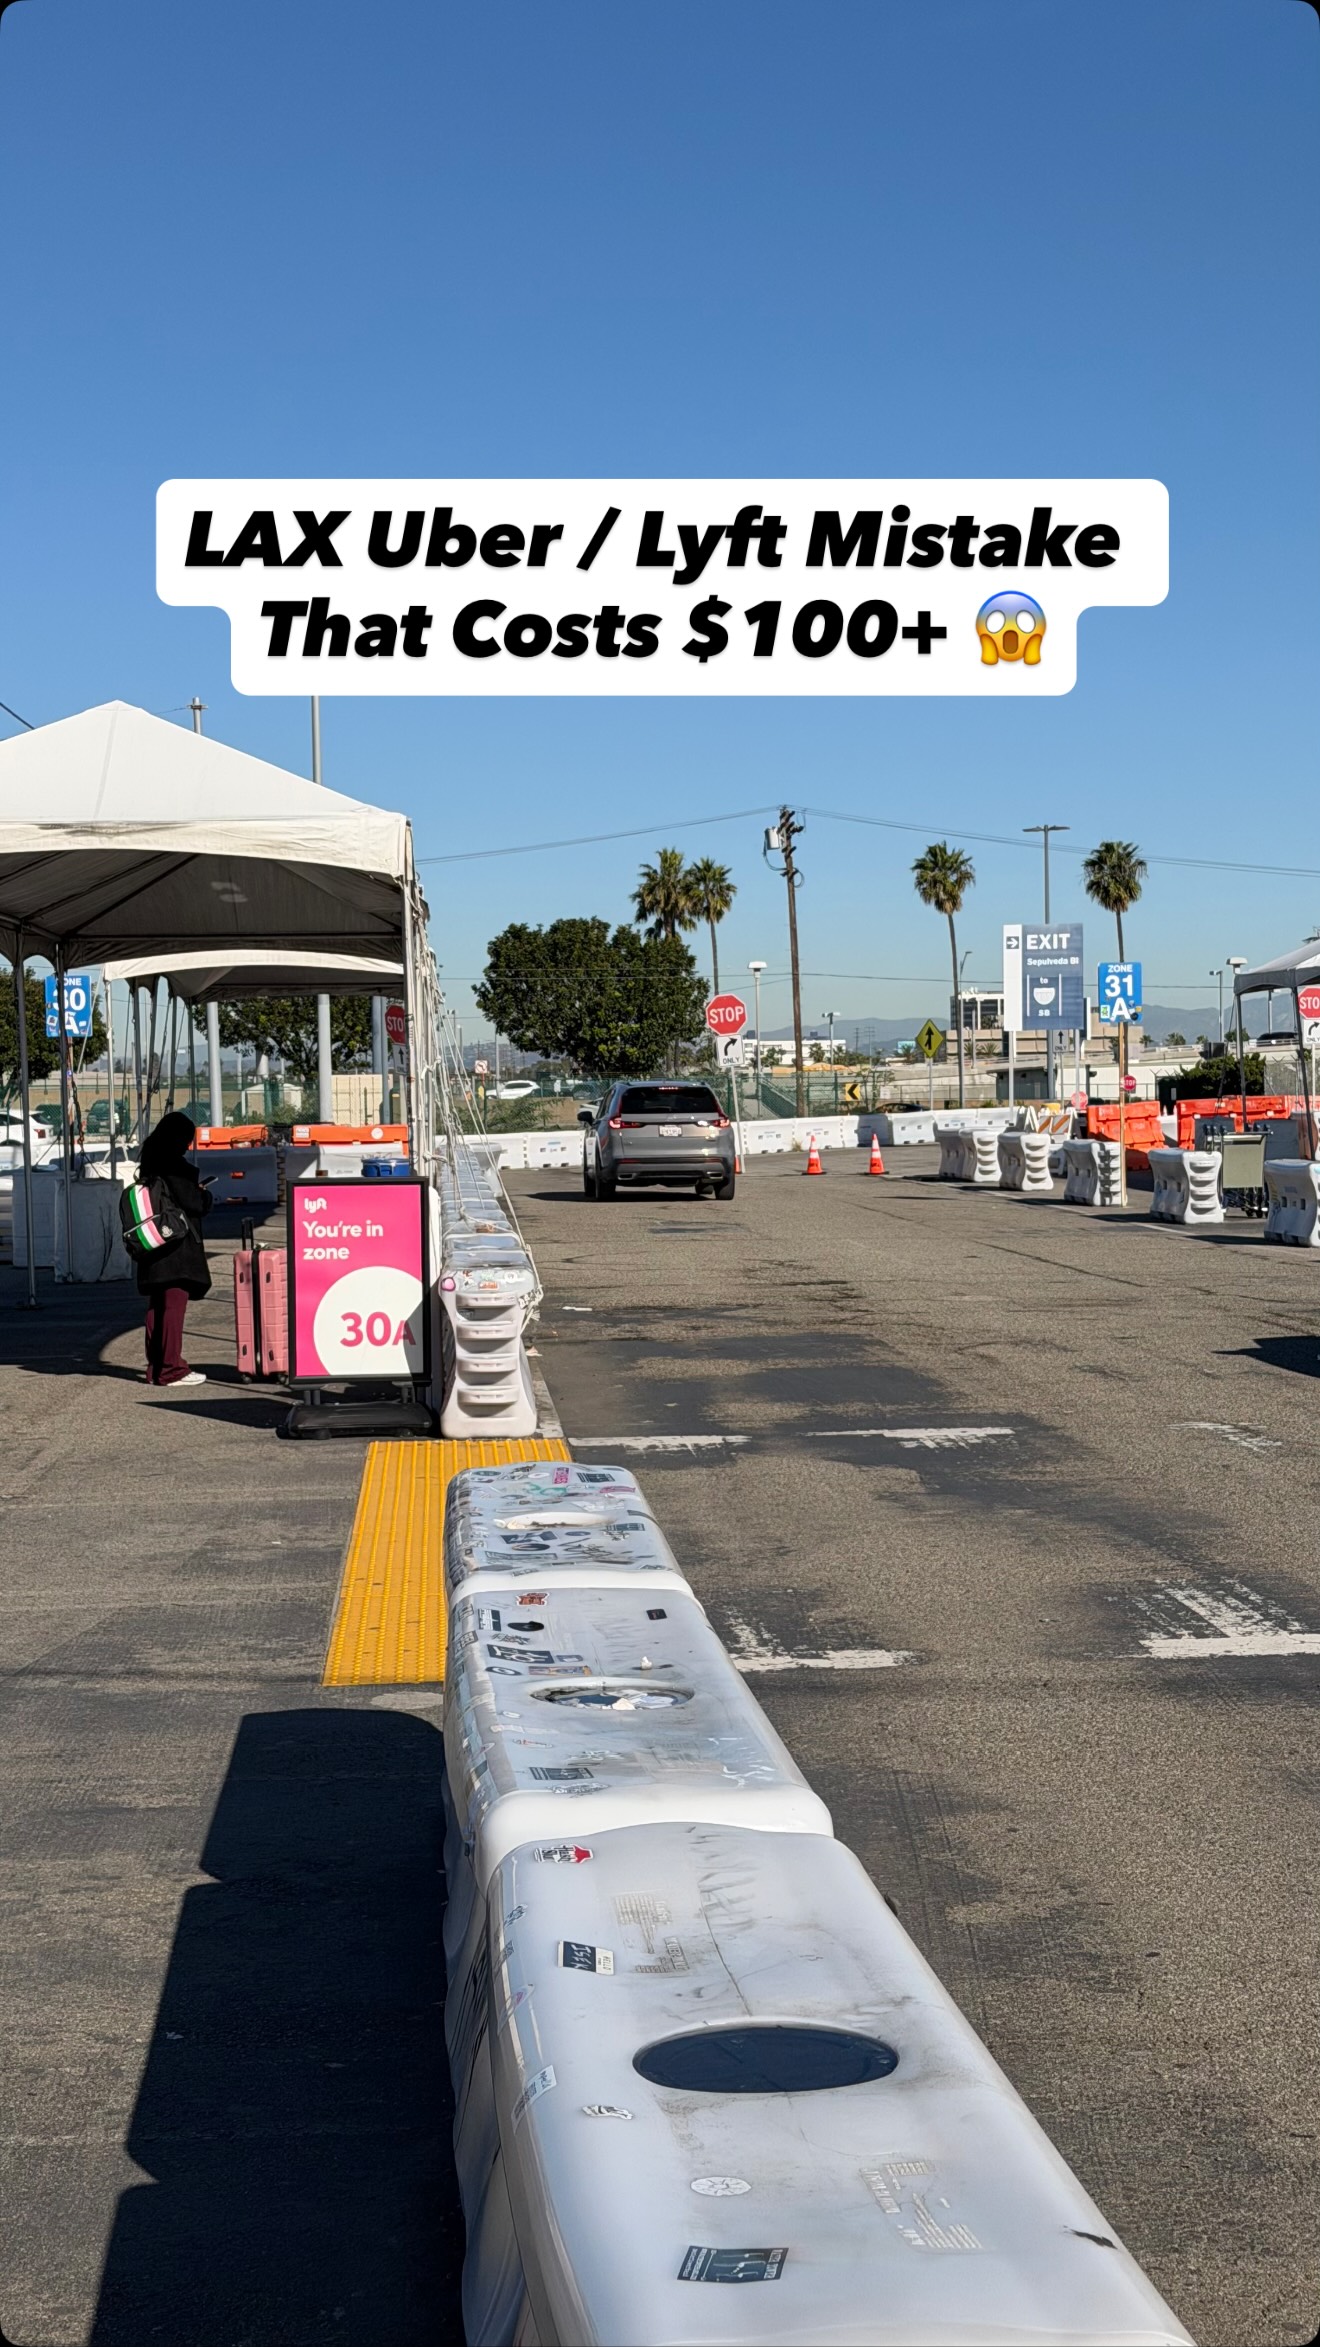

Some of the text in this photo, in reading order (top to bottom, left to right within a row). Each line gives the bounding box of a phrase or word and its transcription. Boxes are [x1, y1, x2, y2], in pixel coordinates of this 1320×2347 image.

[1026, 933, 1071, 950] EXIT
[1026, 957, 1068, 967] Sepulveda
[1107, 964, 1133, 973] ZONE
[64, 977, 82, 986] ONE
[1039, 976, 1049, 984] to
[1104, 974, 1134, 997] 31
[1110, 997, 1131, 1021] A
[1299, 996, 1320, 1010] STO
[709, 1005, 744, 1024] STOP
[1038, 1009, 1051, 1017] SB
[387, 1015, 405, 1033] STO
[722, 1056, 741, 1065] ONLY
[304, 1197, 328, 1214] lyft
[302, 1219, 384, 1239] You're in
[303, 1246, 350, 1261] zone
[340, 1311, 417, 1348] 30A
